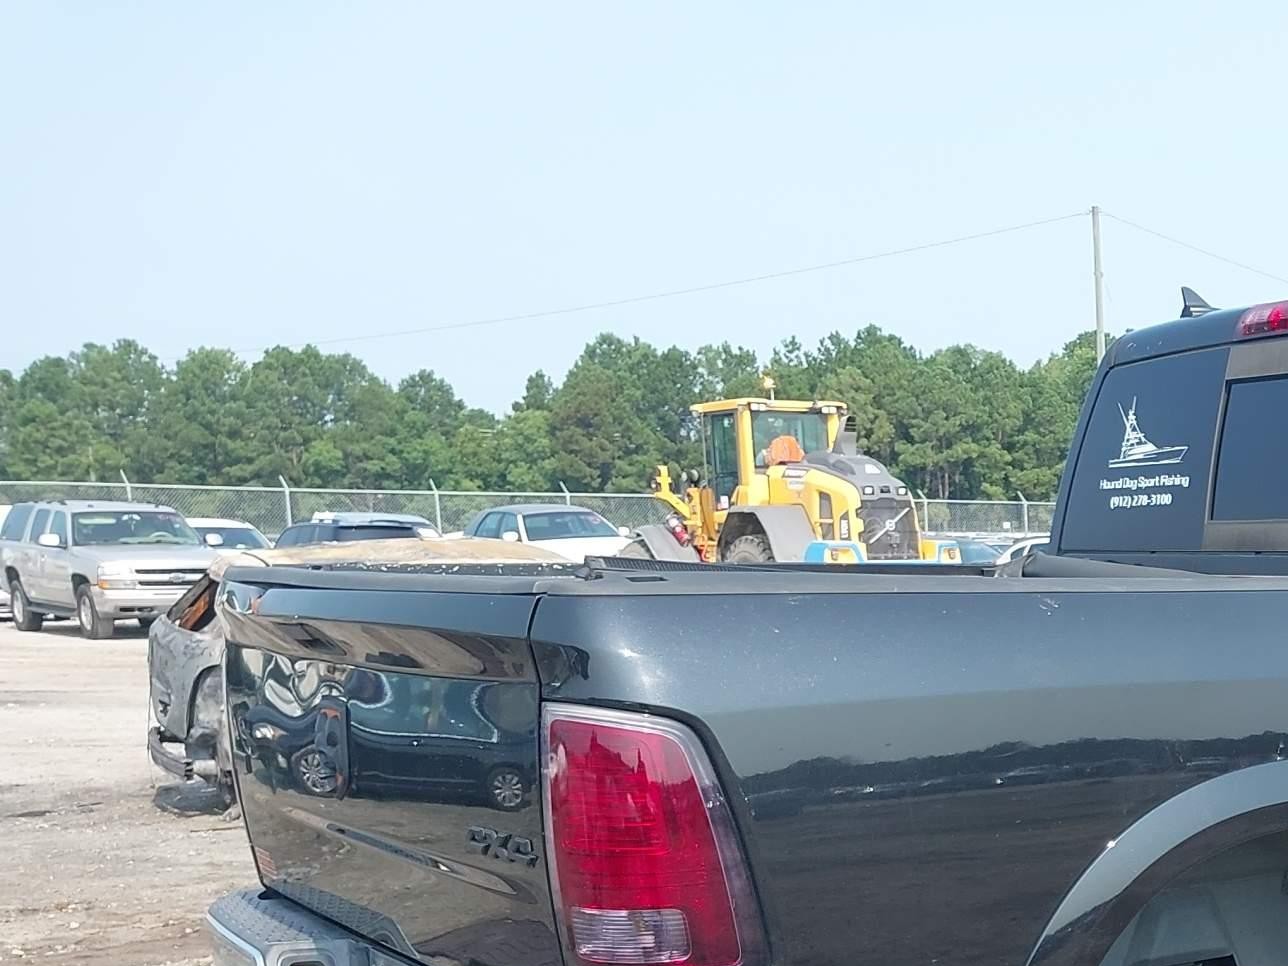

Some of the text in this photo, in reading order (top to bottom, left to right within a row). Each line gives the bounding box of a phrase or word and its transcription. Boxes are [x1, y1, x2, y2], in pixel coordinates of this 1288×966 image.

[1100, 474, 1189, 490] Hound Dog Sport Fishing
[1110, 493, 1172, 509] (912) 278-3100
